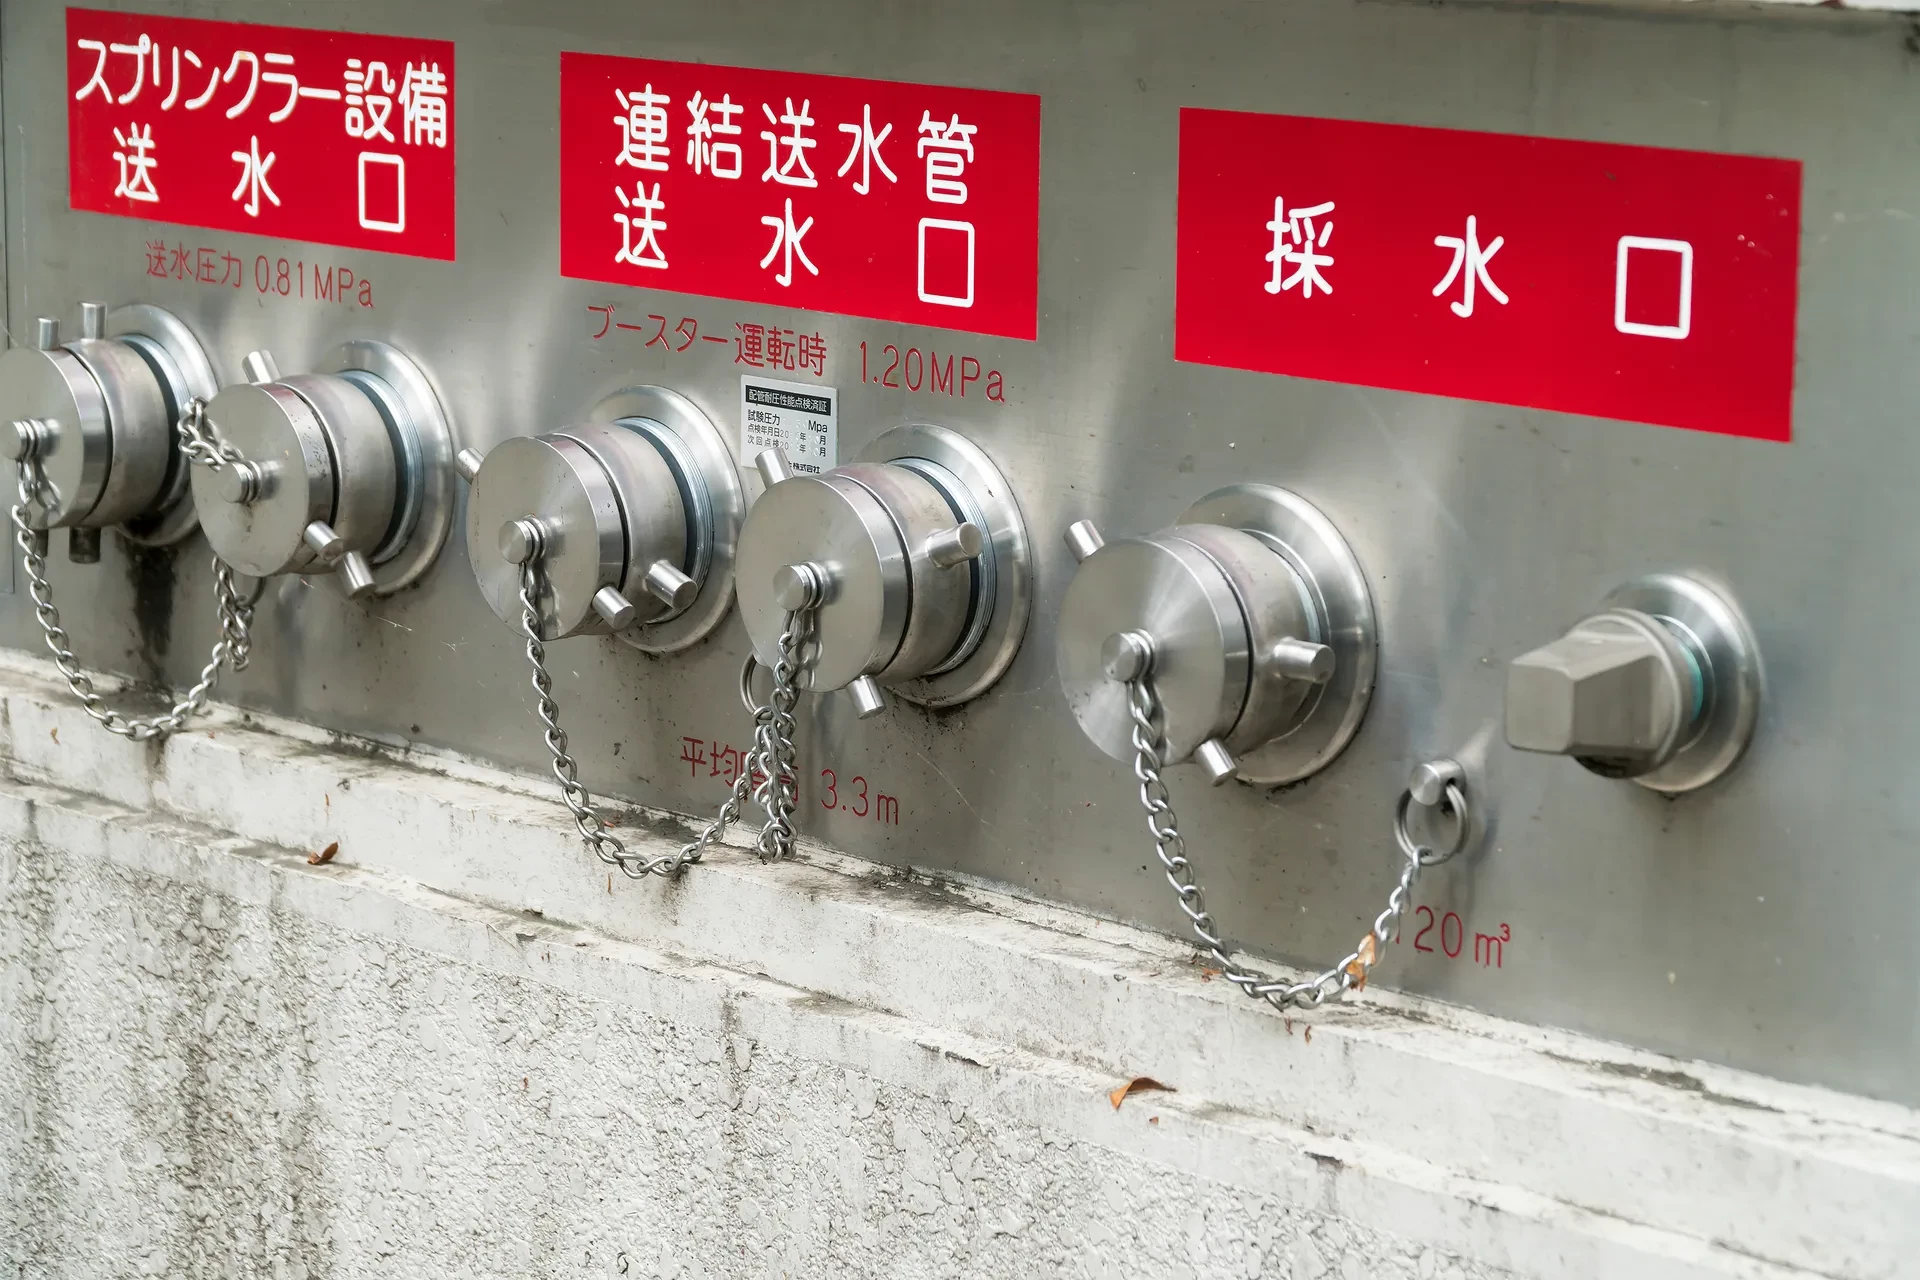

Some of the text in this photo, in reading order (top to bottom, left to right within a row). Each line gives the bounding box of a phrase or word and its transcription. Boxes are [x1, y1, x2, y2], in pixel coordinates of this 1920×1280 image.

[75, 33, 447, 148] スプリンクラー設備
[113, 122, 405, 232] 送水口
[613, 83, 977, 205] 連結送水管
[146, 240, 242, 288] 送水圧力
[613, 181, 975, 308] 送水口
[1264, 196, 1693, 340] 採水口
[587, 304, 1005, 404] ブースター運転時 1.20MPa
[748, 388, 827, 412] 配管耐圧性能点検済証
[747, 409, 781, 426] 試験圧力
[808, 420, 828, 433] Mpa
[788, 460, 820, 474] 株式会社
[821, 768, 899, 825] 3.3m
